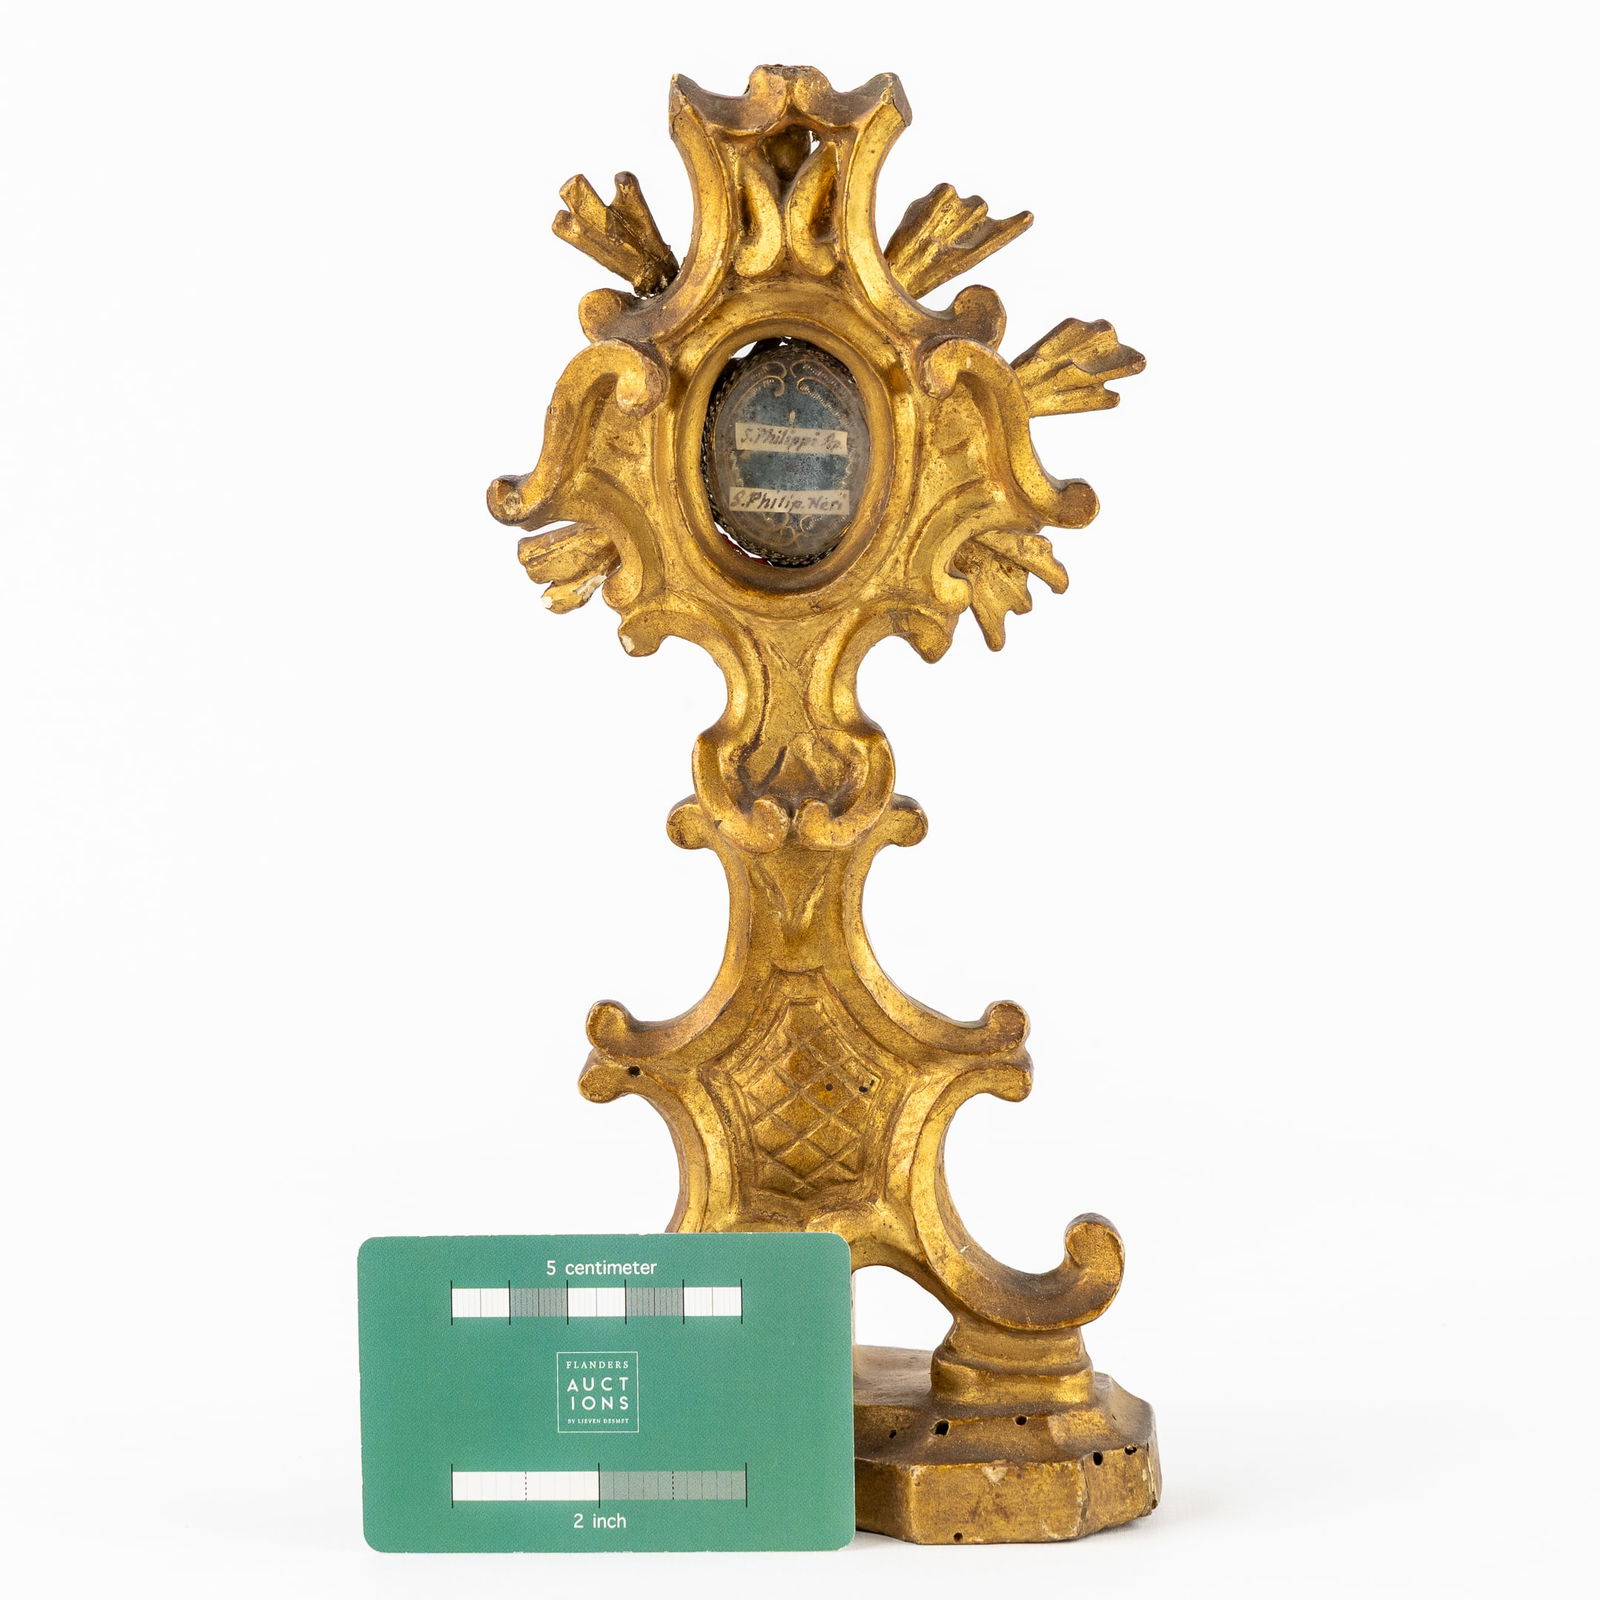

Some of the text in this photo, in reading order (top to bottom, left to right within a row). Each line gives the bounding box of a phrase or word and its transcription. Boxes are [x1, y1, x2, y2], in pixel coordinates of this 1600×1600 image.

[546, 1260, 657, 1276] 5 centimeter
[566, 1360, 629, 1369] FLANDERS
[567, 1376, 629, 1392] AUCT
[571, 1395, 629, 1411] IONS
[573, 1513, 627, 1529] 2 inch
